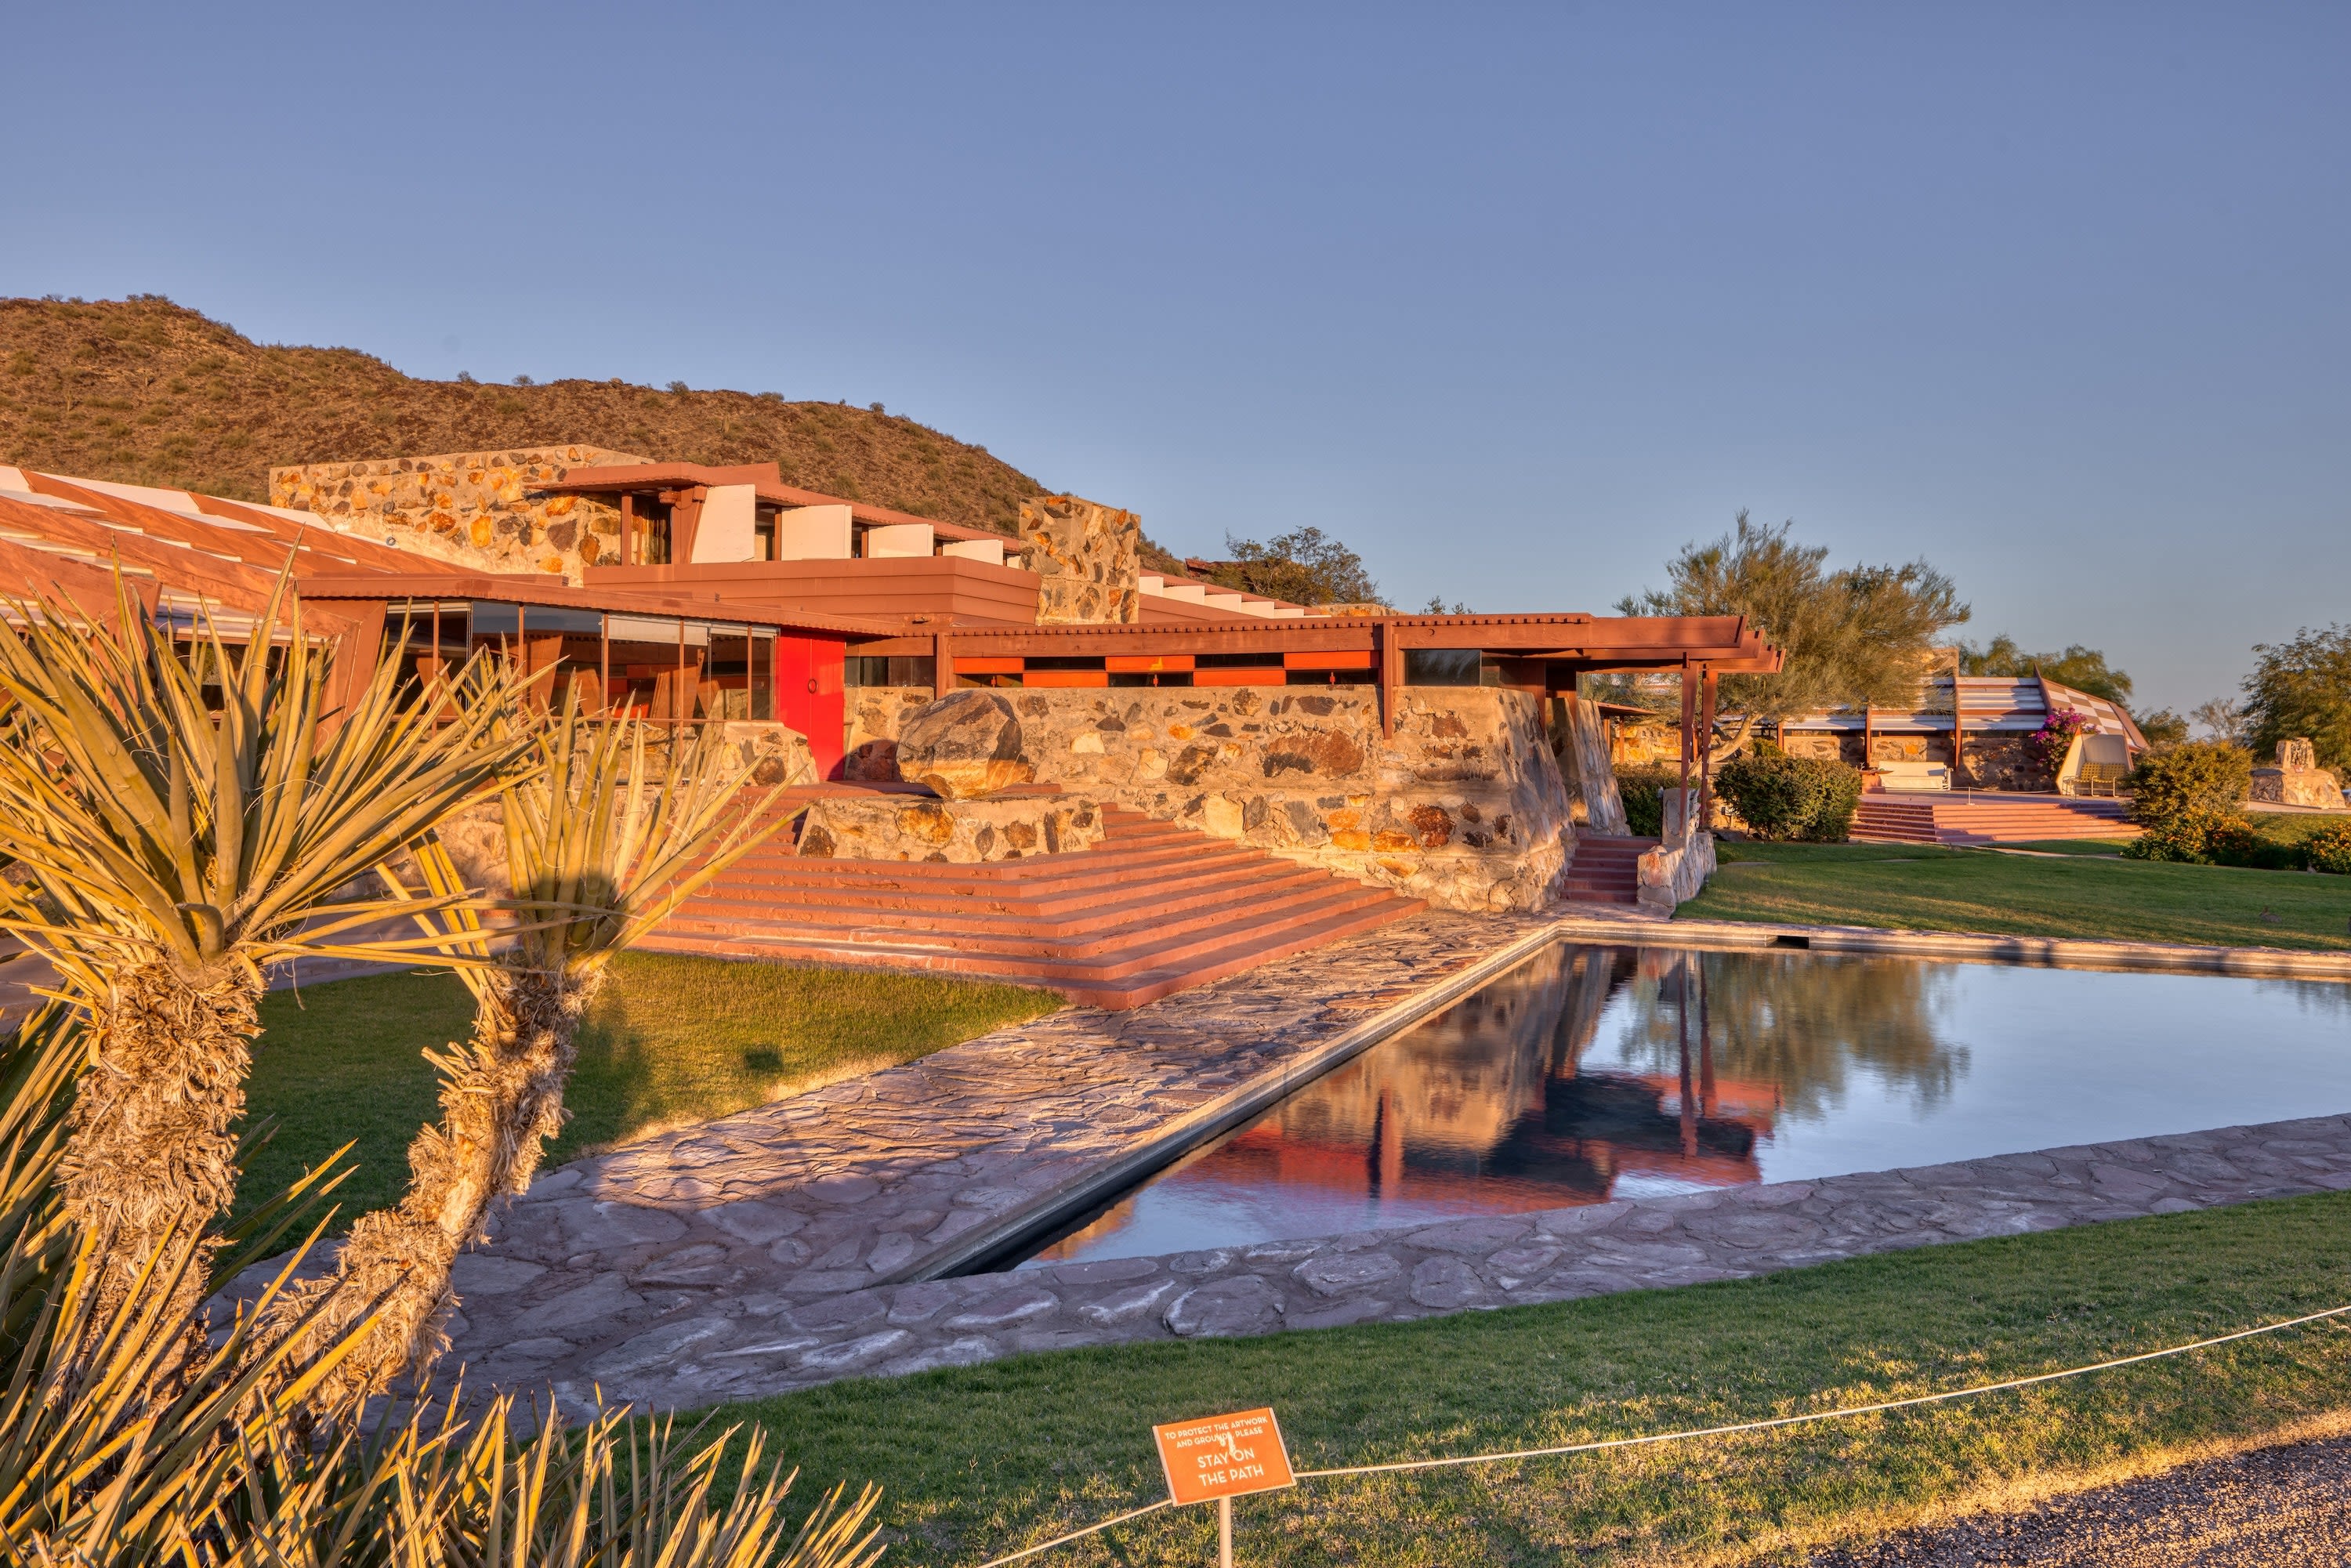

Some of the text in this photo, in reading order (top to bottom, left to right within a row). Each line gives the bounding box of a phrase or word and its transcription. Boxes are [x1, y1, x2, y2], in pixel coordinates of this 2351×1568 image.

[1178, 1426, 1212, 1437] PROTECT
[1214, 1423, 1229, 1432] THE
[1231, 1417, 1268, 1429] ARTWORK
[1236, 1427, 1263, 1437] PLEASE
[1197, 1448, 1255, 1468] STAY ON
[1198, 1464, 1264, 1487] THE PATH
